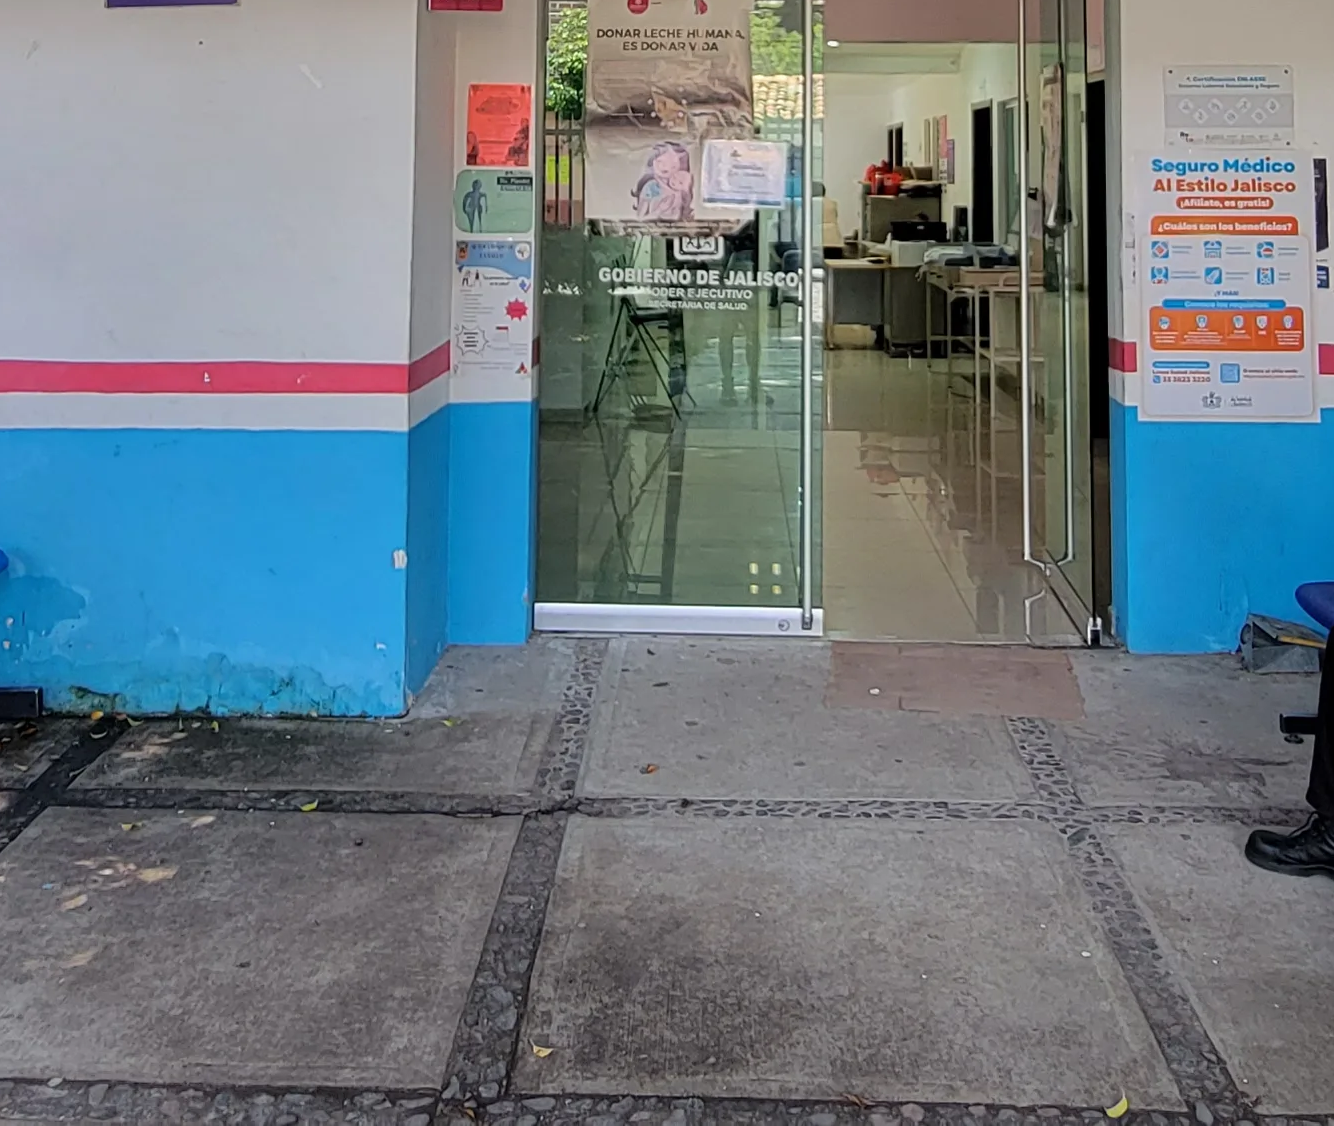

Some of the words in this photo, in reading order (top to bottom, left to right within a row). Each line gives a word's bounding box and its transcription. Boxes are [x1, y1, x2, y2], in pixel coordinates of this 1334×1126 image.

[597, 29, 641, 38] DONAR
[644, 29, 683, 38] LECHE
[623, 41, 637, 51] ES
[641, 41, 686, 51] DONAR
[689, 42, 719, 51] VDA
[1152, 158, 1219, 176] Seguro
[1223, 157, 1295, 173] Médico
[1153, 178, 1171, 192] Al
[1176, 176, 1227, 192] Estilo
[1230, 177, 1296, 192] Jalisco
[1237, 198, 1269, 208] gratis!
[1158, 222, 1198, 232] ¿Cuáles
[1235, 223, 1292, 231] beneficios?
[599, 267, 691, 284] GOBIERNO
[697, 269, 719, 285] DE
[724, 271, 799, 287] JALISCO
[646, 287, 685, 298] ODER
[687, 288, 753, 299] EJECUTIVO
[649, 300, 702, 309] SECRETARIA
[704, 302, 716, 310] DE
[718, 302, 748, 310] SALUD
